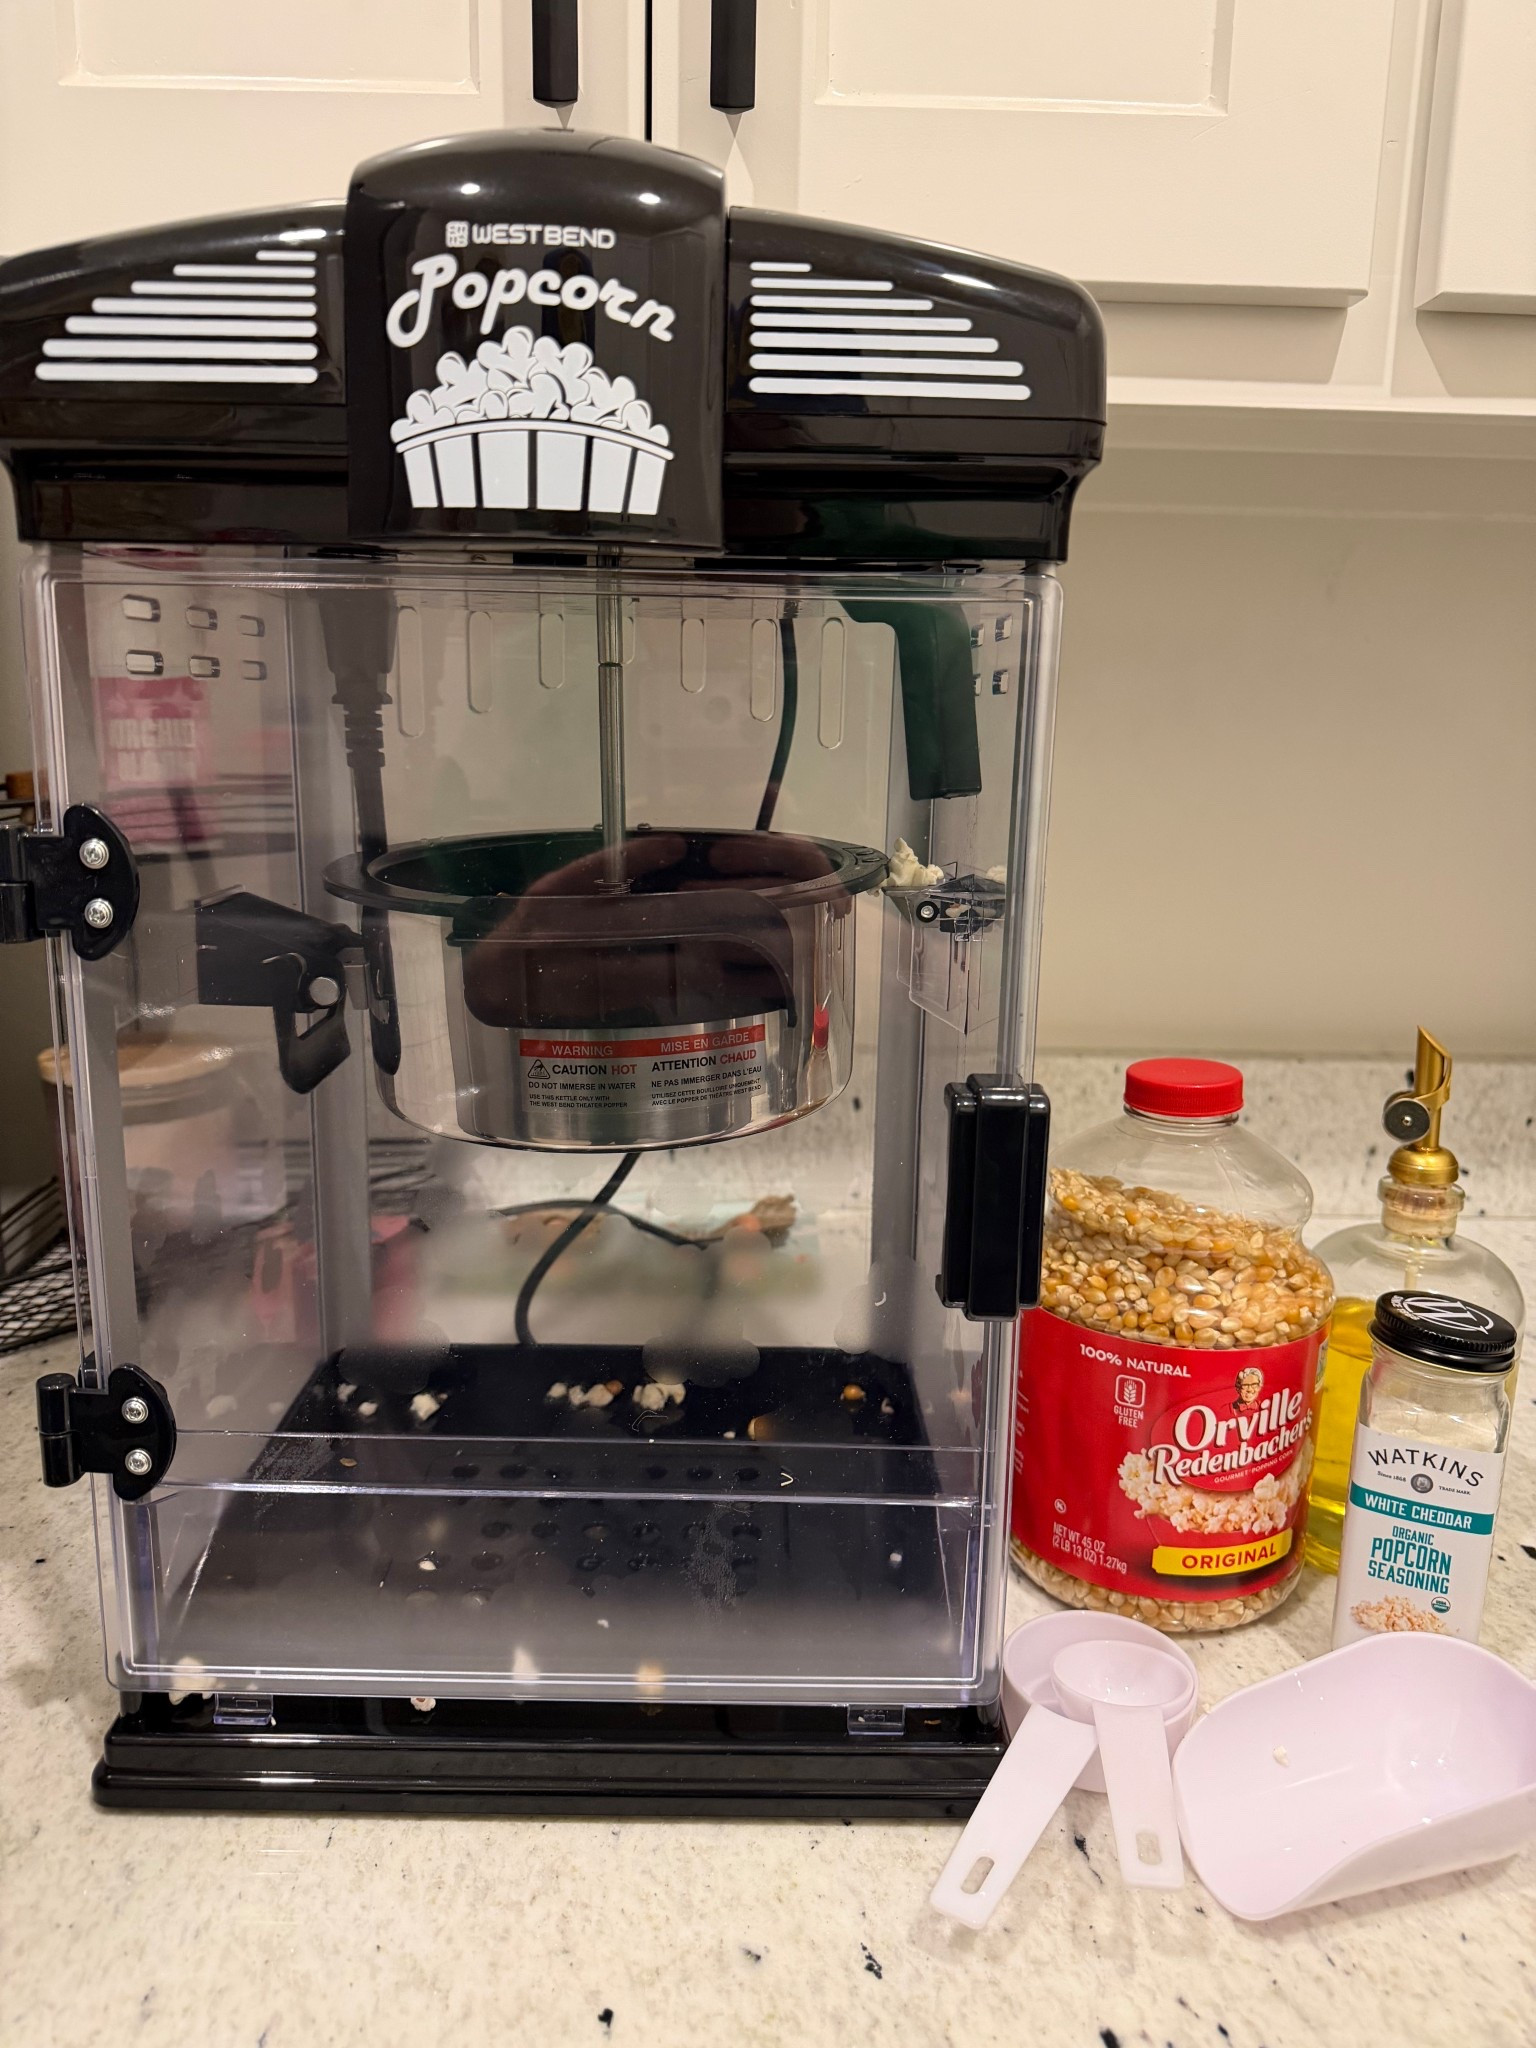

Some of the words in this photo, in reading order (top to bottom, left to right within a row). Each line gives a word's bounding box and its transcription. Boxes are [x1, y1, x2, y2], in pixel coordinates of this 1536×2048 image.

[386, 253, 676, 347] Popcorn
[551, 1045, 613, 1056] WARNING
[660, 1040, 690, 1053] MISE
[693, 1038, 709, 1049] EN
[712, 1031, 750, 1047] GARDE
[552, 1064, 607, 1075] CAUTION
[611, 1064, 638, 1075] HOT
[651, 1055, 717, 1072] ATTENTION
[720, 1049, 757, 1065] CHAUD
[528, 1081, 540, 1089] DO
[541, 1082, 558, 1090] NOT
[608, 1082, 636, 1090] WATER
[651, 1080, 662, 1088] NE
[663, 1078, 679, 1086] PAS
[681, 1073, 721, 1085] IMMERGER
[722, 1070, 742, 1080] DANS
[743, 1065, 762, 1076] L'EAU
[1079, 1343, 1123, 1366] 100%
[1126, 1357, 1192, 1378] NATURAL
[1113, 1405, 1144, 1420] GLUTEN
[1118, 1415, 1138, 1428] FREE
[1174, 1387, 1303, 1451] Orville
[1213, 1470, 1247, 1484] GOURMET
[1251, 1458, 1278, 1474] POPPING
[1367, 1448, 1484, 1487] WATKINS
[1438, 1485, 1455, 1493] TRADE
[1364, 1492, 1408, 1516] WHITE
[1411, 1505, 1473, 1529] CHEDDAR
[1053, 1521, 1068, 1538] NET
[1068, 1529, 1081, 1544] WT
[1081, 1536, 1092, 1549] 45
[1093, 1540, 1105, 1554] OZ
[1392, 1525, 1434, 1546] ORGANIC
[1052, 1534, 1060, 1548] (2
[1060, 1538, 1070, 1553] LB
[1072, 1544, 1082, 1558] 13
[1083, 1548, 1097, 1565] OZ)
[1099, 1554, 1127, 1575] 1.27kg
[1181, 1542, 1277, 1570] ORIGINAL
[1370, 1537, 1452, 1576] POPCORN
[1367, 1559, 1450, 1595] SEASONING
